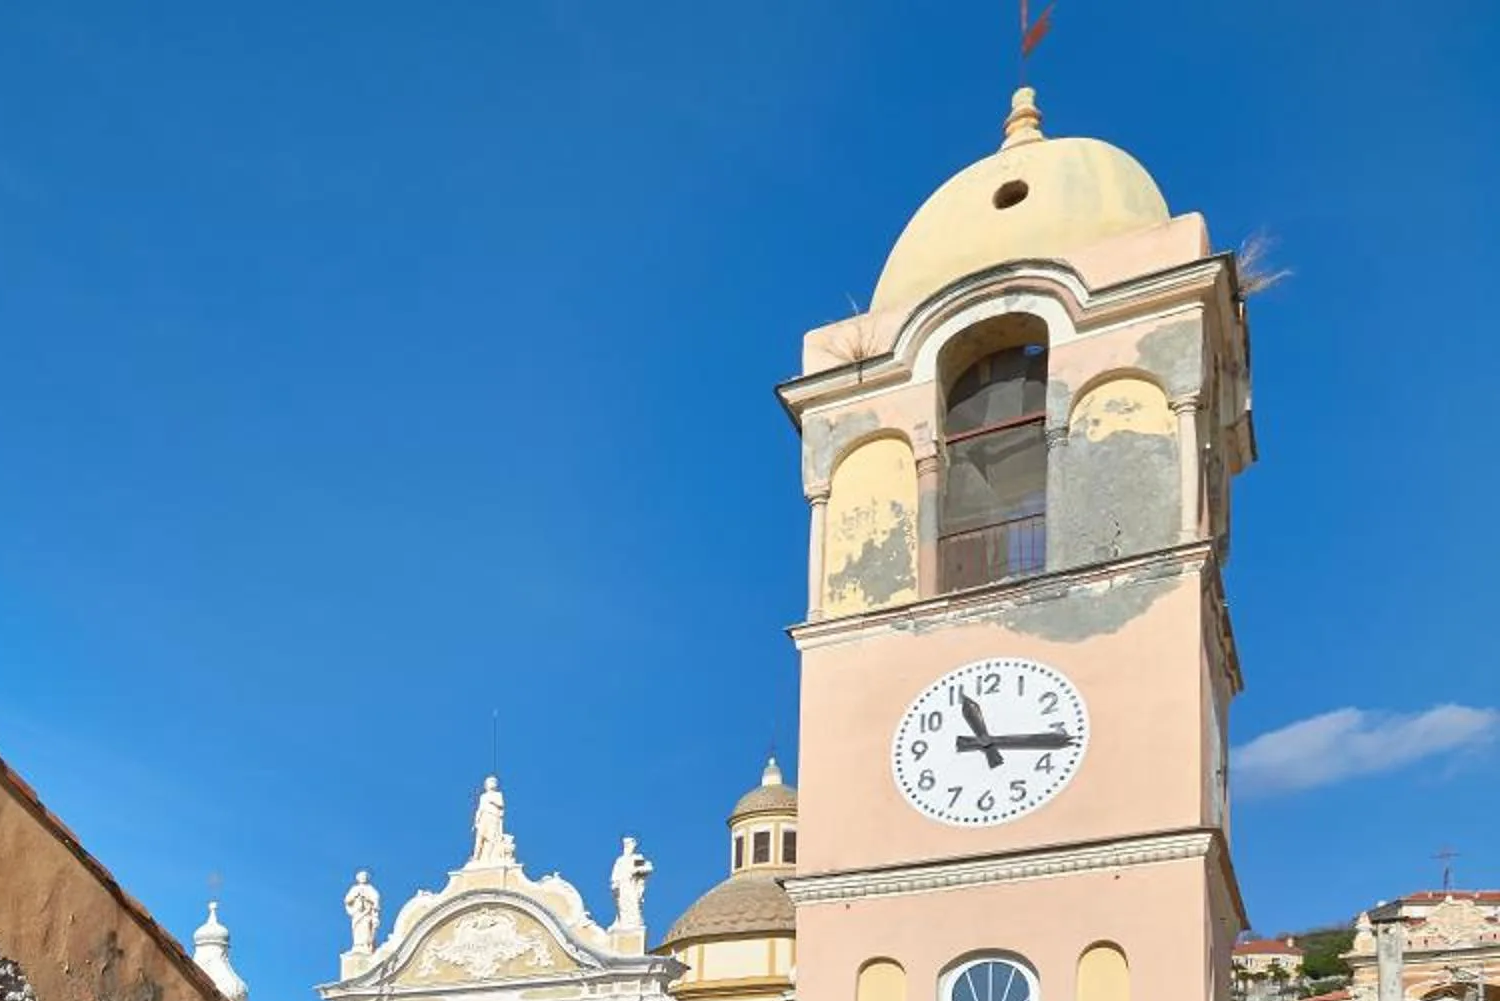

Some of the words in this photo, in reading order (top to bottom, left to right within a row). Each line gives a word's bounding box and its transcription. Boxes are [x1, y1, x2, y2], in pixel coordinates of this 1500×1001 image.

[949, 684, 965, 706] 11
[976, 673, 1001, 696] 12
[1018, 675, 1025, 697] 1
[1038, 692, 1059, 715] 2
[920, 711, 942, 734] 10
[911, 740, 929, 762] 9
[1034, 752, 1055, 774] 4
[917, 769, 936, 791] 8
[1009, 780, 1027, 802] 5
[947, 786, 963, 808] 7
[977, 790, 995, 812] 6
